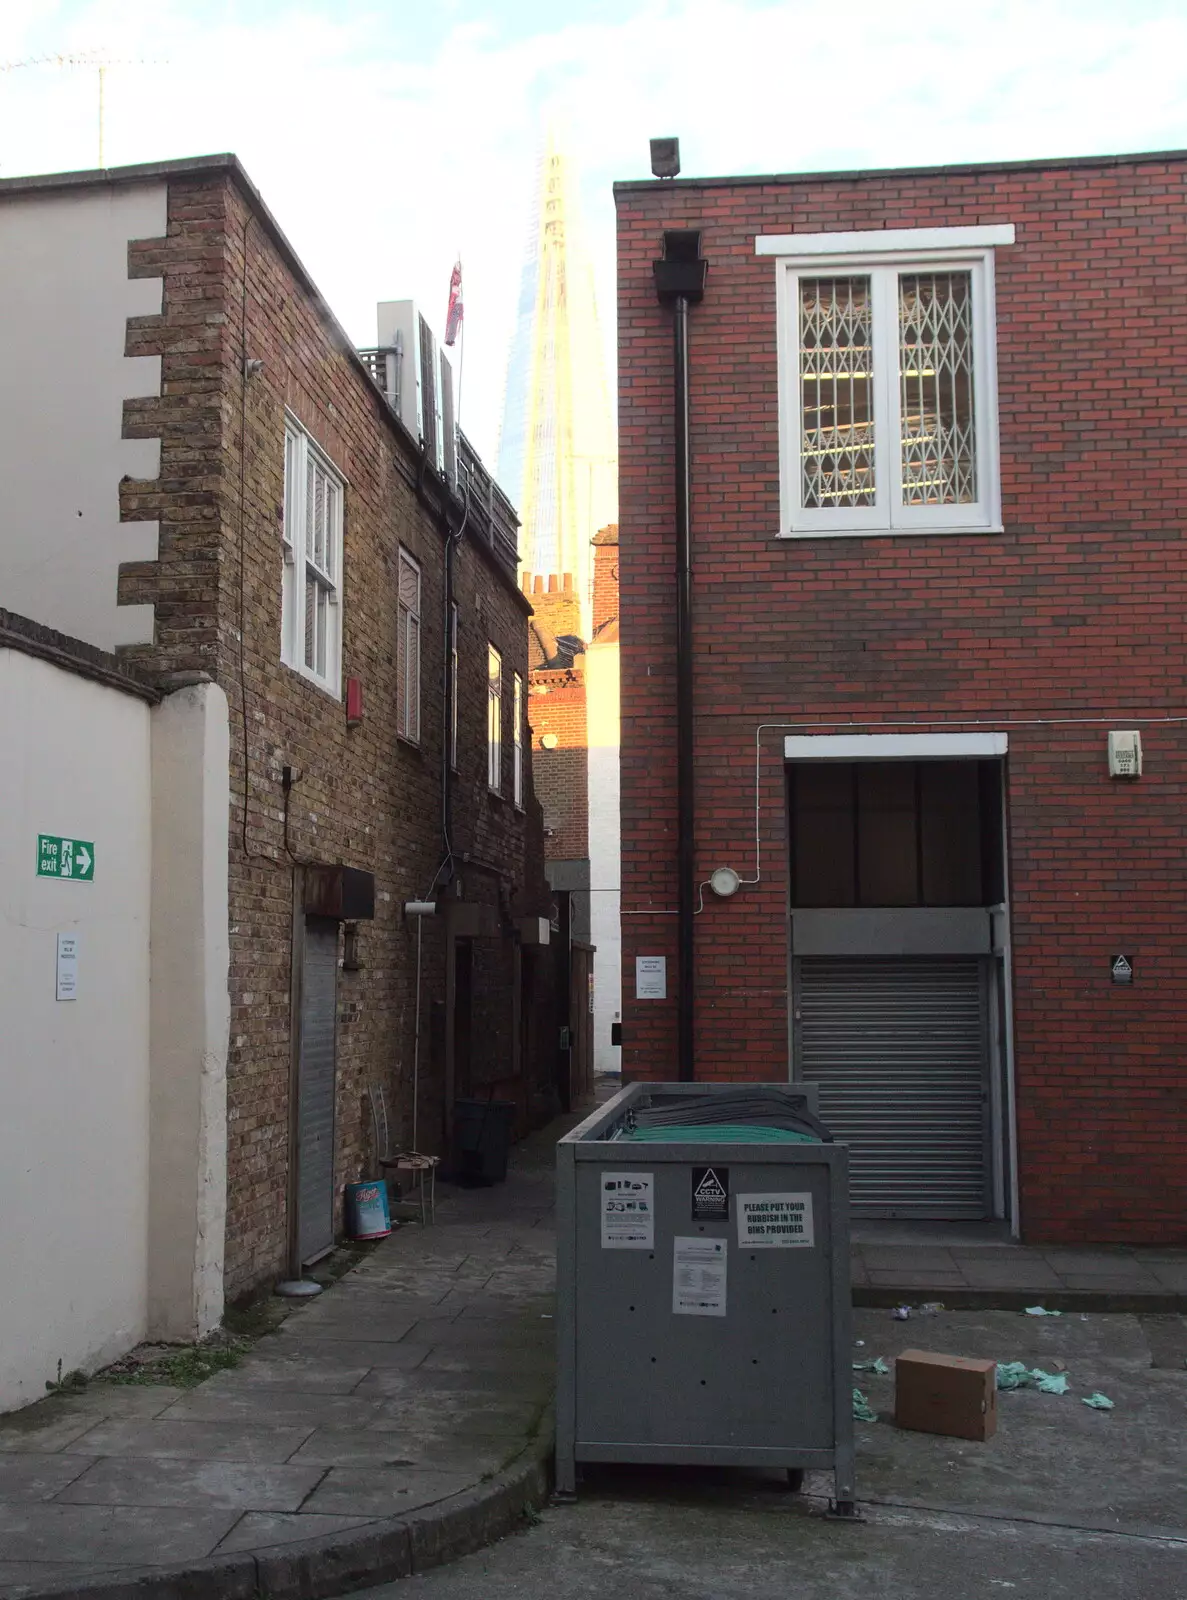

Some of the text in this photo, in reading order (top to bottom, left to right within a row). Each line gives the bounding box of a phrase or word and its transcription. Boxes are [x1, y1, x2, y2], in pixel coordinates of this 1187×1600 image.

[41, 838, 58, 855] Fire
[41, 857, 57, 872] exit
[696, 1195, 726, 1203] WARNING
[744, 1202, 805, 1212] PLEASE PUT YOUR
[747, 1213, 803, 1223] RUBBISH IN THE
[747, 1224, 804, 1234] BINS PROVIDED
